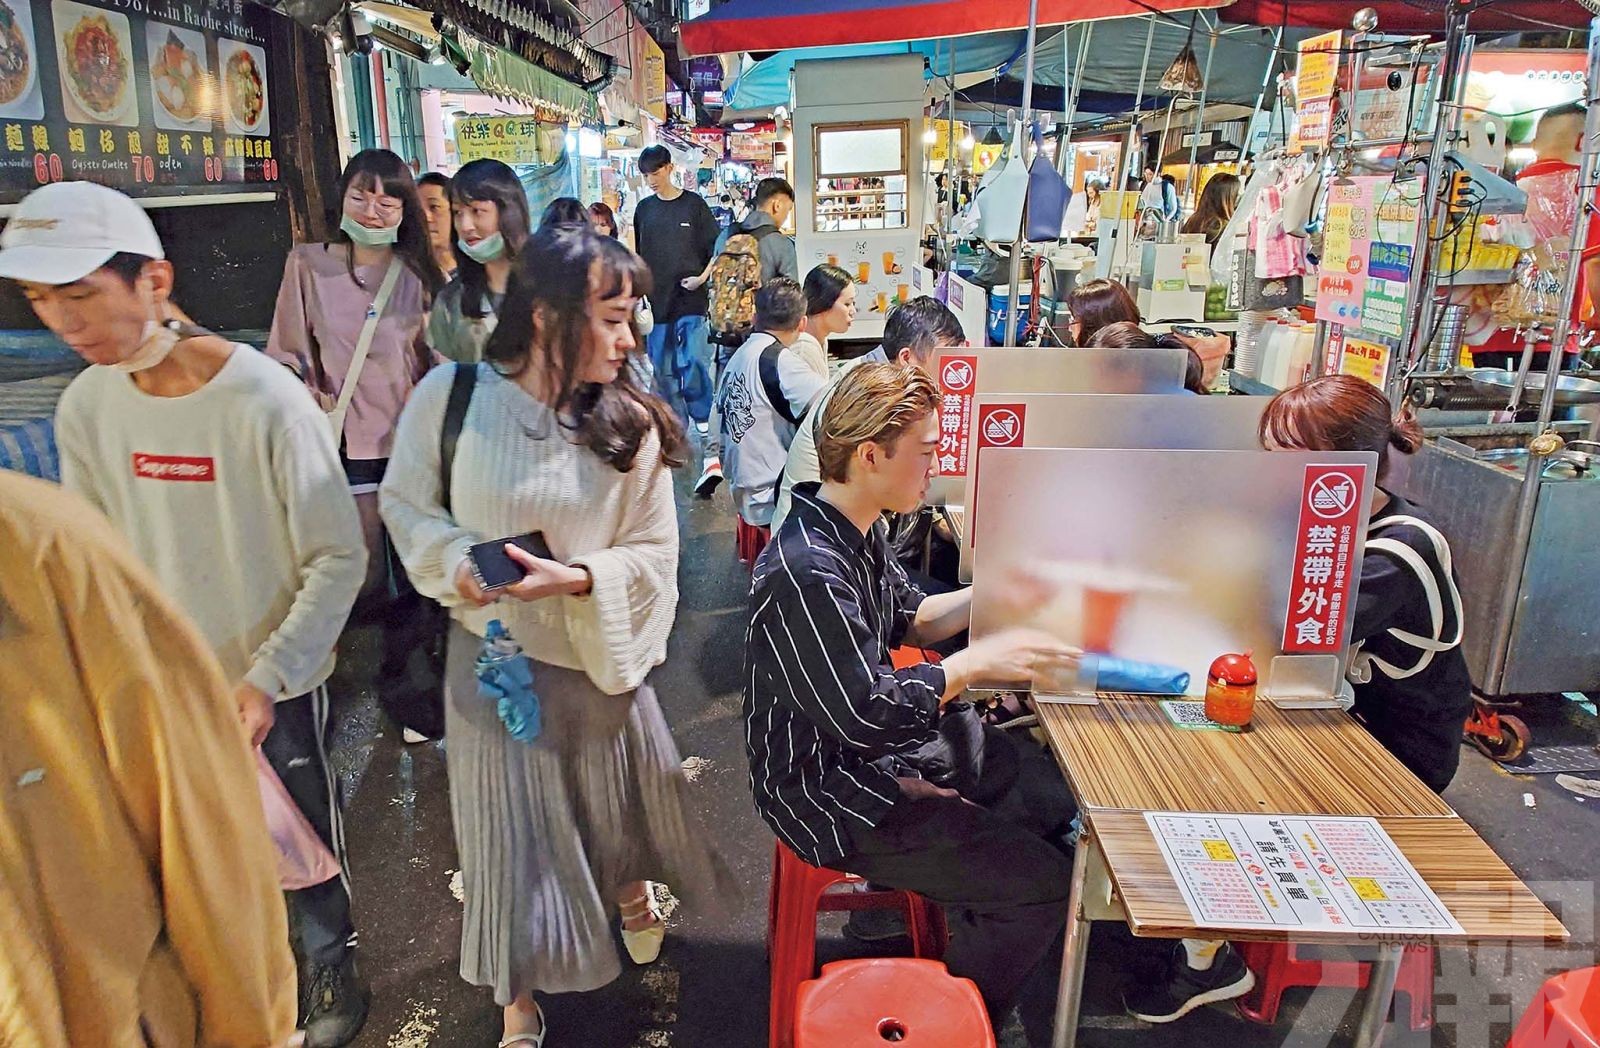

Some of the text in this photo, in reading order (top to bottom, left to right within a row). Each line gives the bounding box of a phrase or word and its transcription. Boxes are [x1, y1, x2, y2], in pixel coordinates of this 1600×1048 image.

[183, 3, 222, 32] Raohe
[34, 152, 63, 184] 60
[72, 159, 100, 174] Oyster
[131, 155, 155, 182] 70
[160, 155, 182, 171] oden
[204, 156, 223, 181] 60
[263, 158, 278, 181] 60
[940, 393, 962, 473] 禁帶外食
[1294, 524, 1337, 645] 禁帶外食
[1325, 525, 1352, 645] 垃圾請自行帶走 感謝您的配合
[1256, 841, 1310, 900] 請先買單
